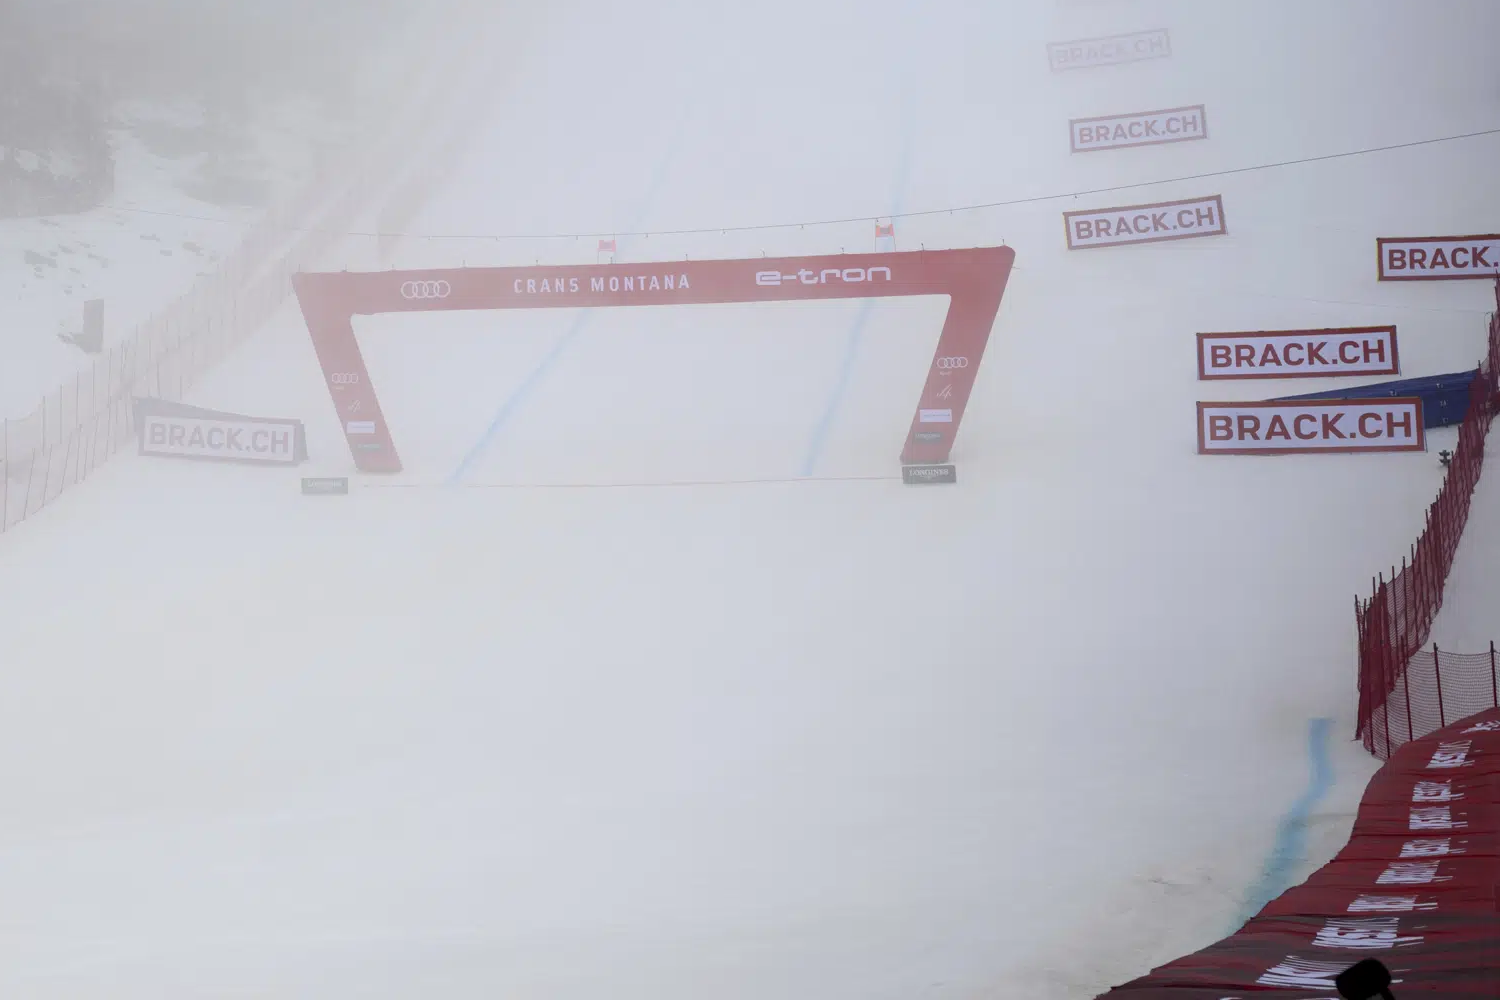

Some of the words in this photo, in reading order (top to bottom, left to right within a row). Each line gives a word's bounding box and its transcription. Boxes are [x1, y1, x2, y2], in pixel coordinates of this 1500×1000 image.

[1055, 36, 1163, 64] BRACKCH
[1079, 114, 1198, 144] BRACK.CH
[1075, 206, 1215, 240] BRACK.CH
[513, 277, 579, 294] CRANS
[590, 274, 690, 292] MONTANA
[755, 266, 891, 286] e-tron
[1210, 339, 1385, 368] BRACK.CH
[150, 423, 289, 454] BRACK.CH
[1209, 411, 1411, 441] BRACK.CH
